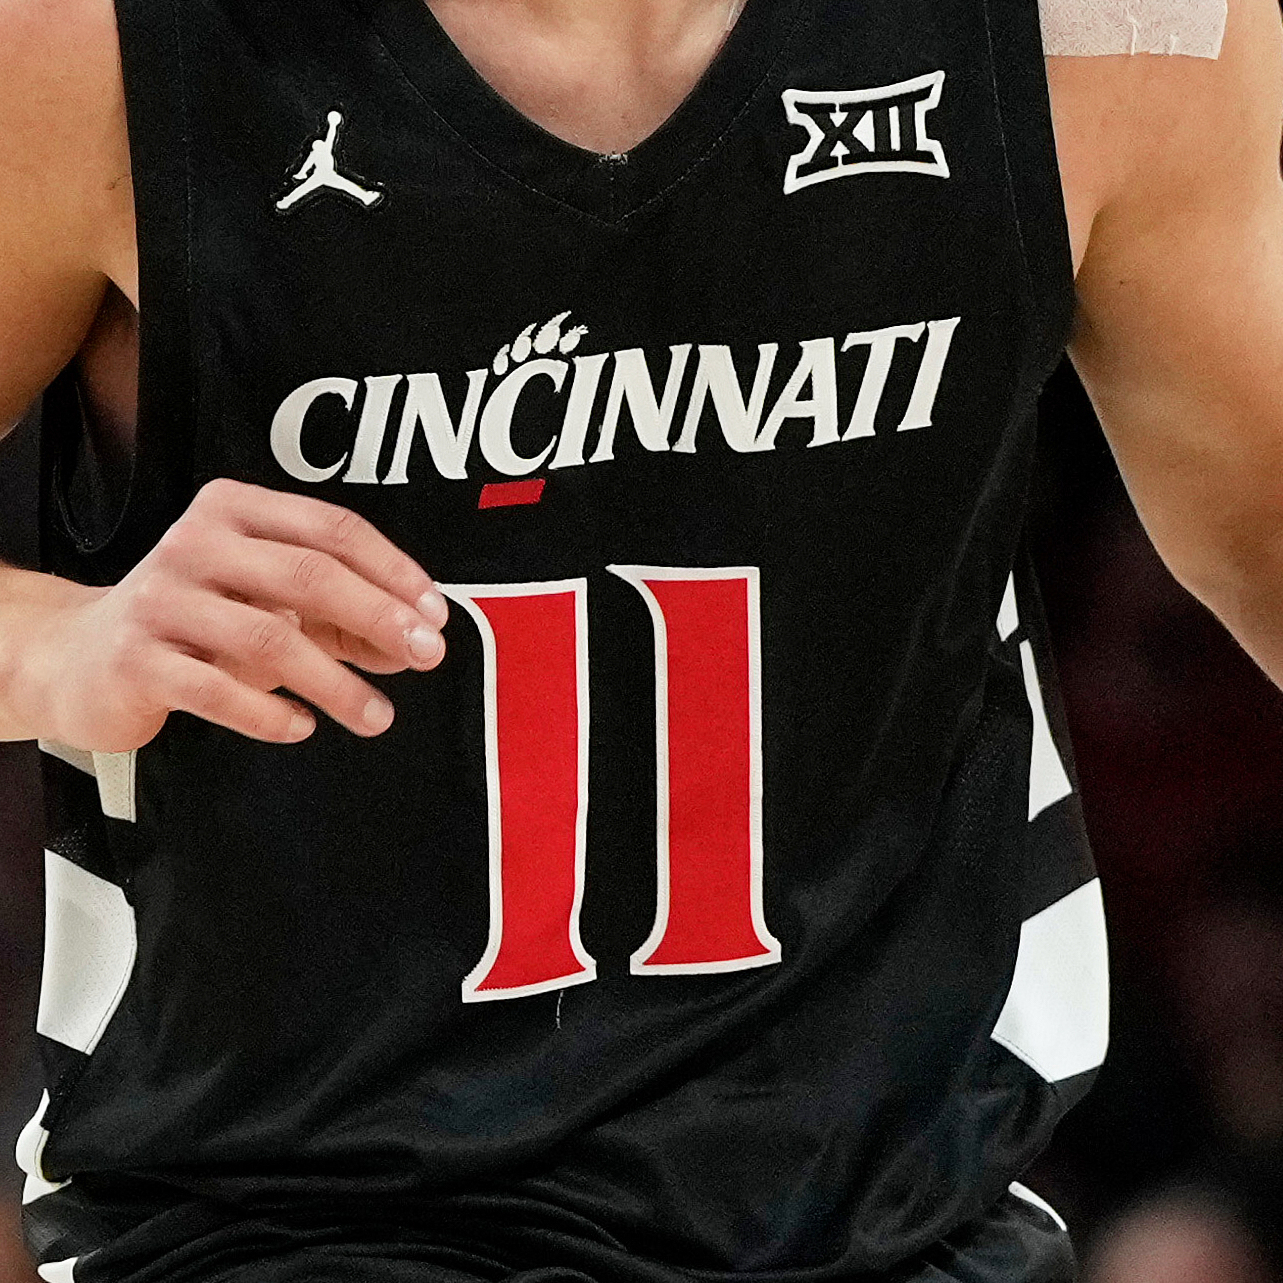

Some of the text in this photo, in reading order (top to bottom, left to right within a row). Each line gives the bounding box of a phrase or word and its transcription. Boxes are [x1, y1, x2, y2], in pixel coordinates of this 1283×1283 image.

[790, 79, 942, 182] XII
[270, 316, 961, 485] CINCINNATI
[434, 564, 783, 1003] 11
